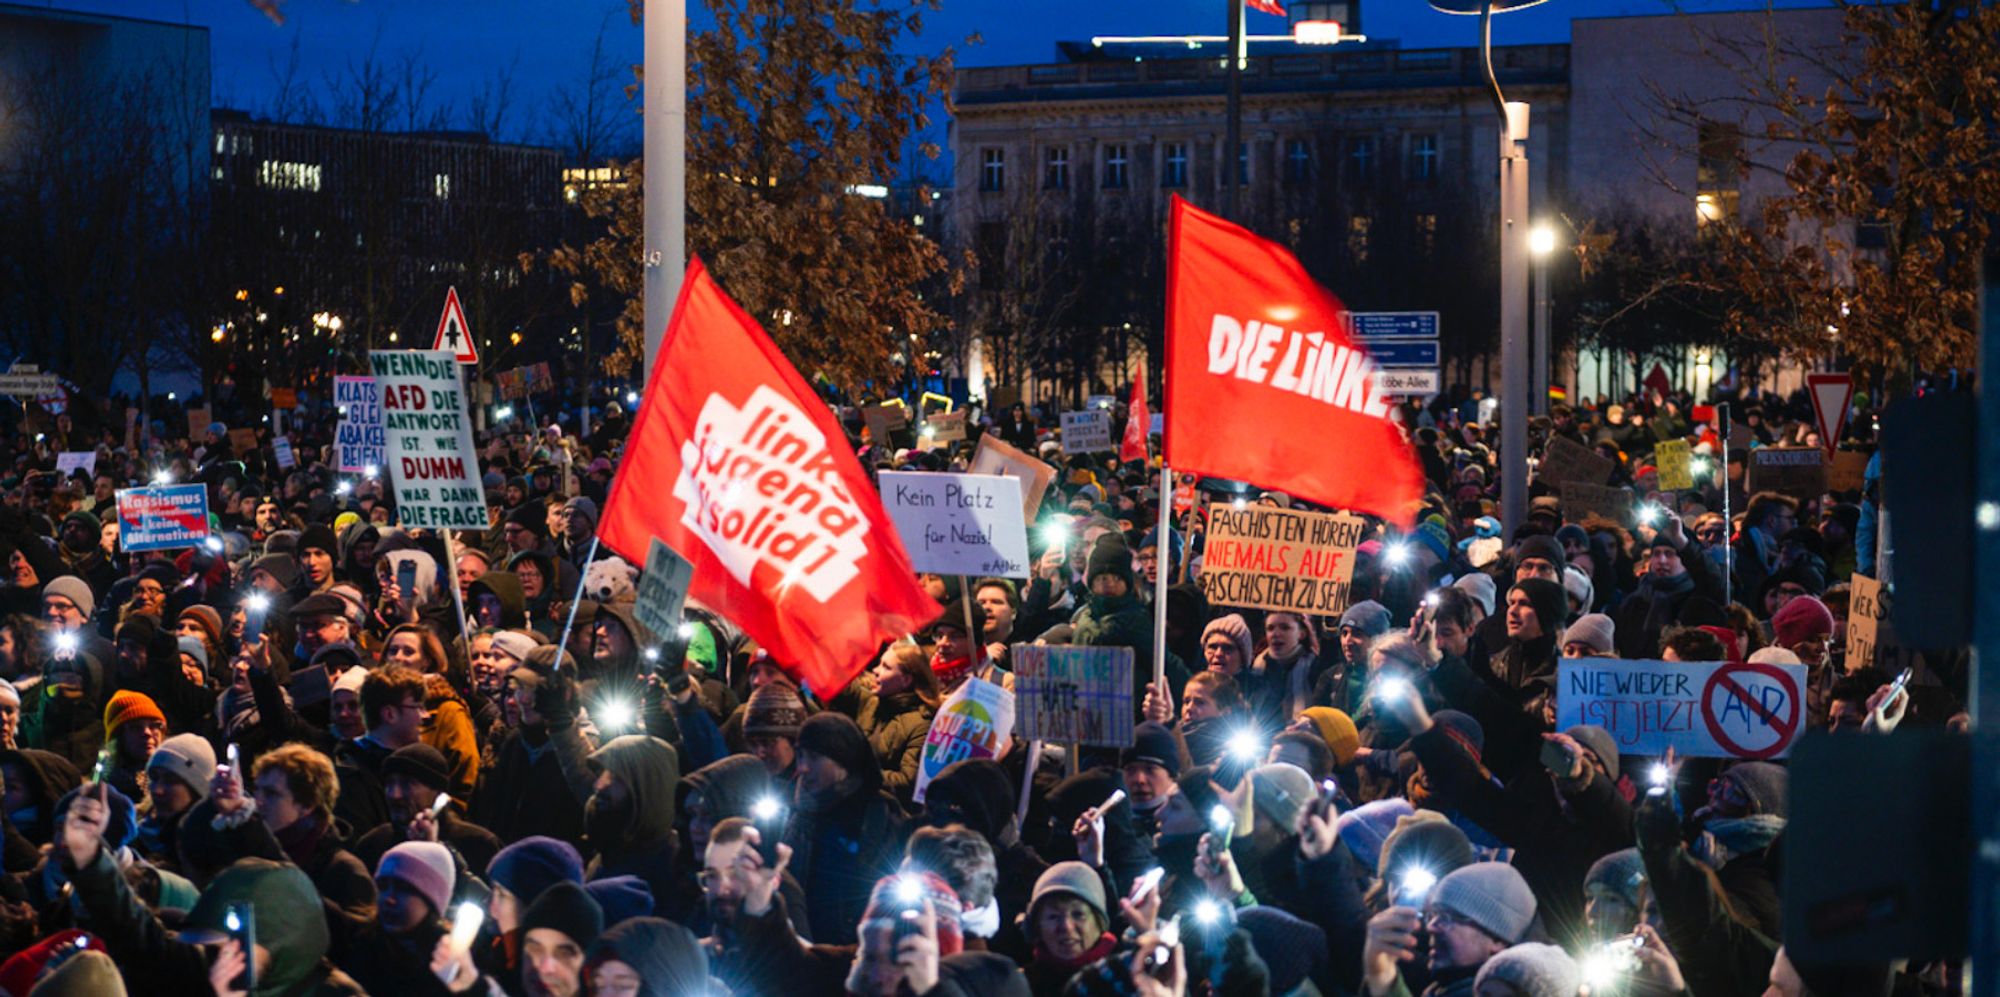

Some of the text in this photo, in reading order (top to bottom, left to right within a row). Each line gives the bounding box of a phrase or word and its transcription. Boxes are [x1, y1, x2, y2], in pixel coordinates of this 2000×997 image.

[1208, 313, 1284, 384] DIE
[371, 354, 456, 380] WENN DIE
[384, 385, 460, 411] AFD DIE
[387, 413, 461, 431] ANTWORT
[434, 437, 459, 450] WIE
[402, 457, 466, 480] DUMM
[124, 493, 201, 508] Rassismus
[402, 488, 480, 502] WAR DANN
[896, 484, 994, 508] Kein Platz
[400, 507, 488, 526] DIE FRAGE
[1210, 508, 1359, 548] FASCHISTEN HÖREN
[127, 529, 206, 545] Alternativen
[925, 524, 992, 551] für Nazis!
[1205, 541, 1291, 573] NIEMALS
[1201, 571, 1296, 609] FASCHISTEN
[1296, 578, 1317, 609] ZU
[1015, 650, 1045, 678] LOVE
[1040, 681, 1078, 712] HATE
[1571, 671, 1693, 698] NIE WIEDER
[1580, 700, 1699, 746] IST JETZT
